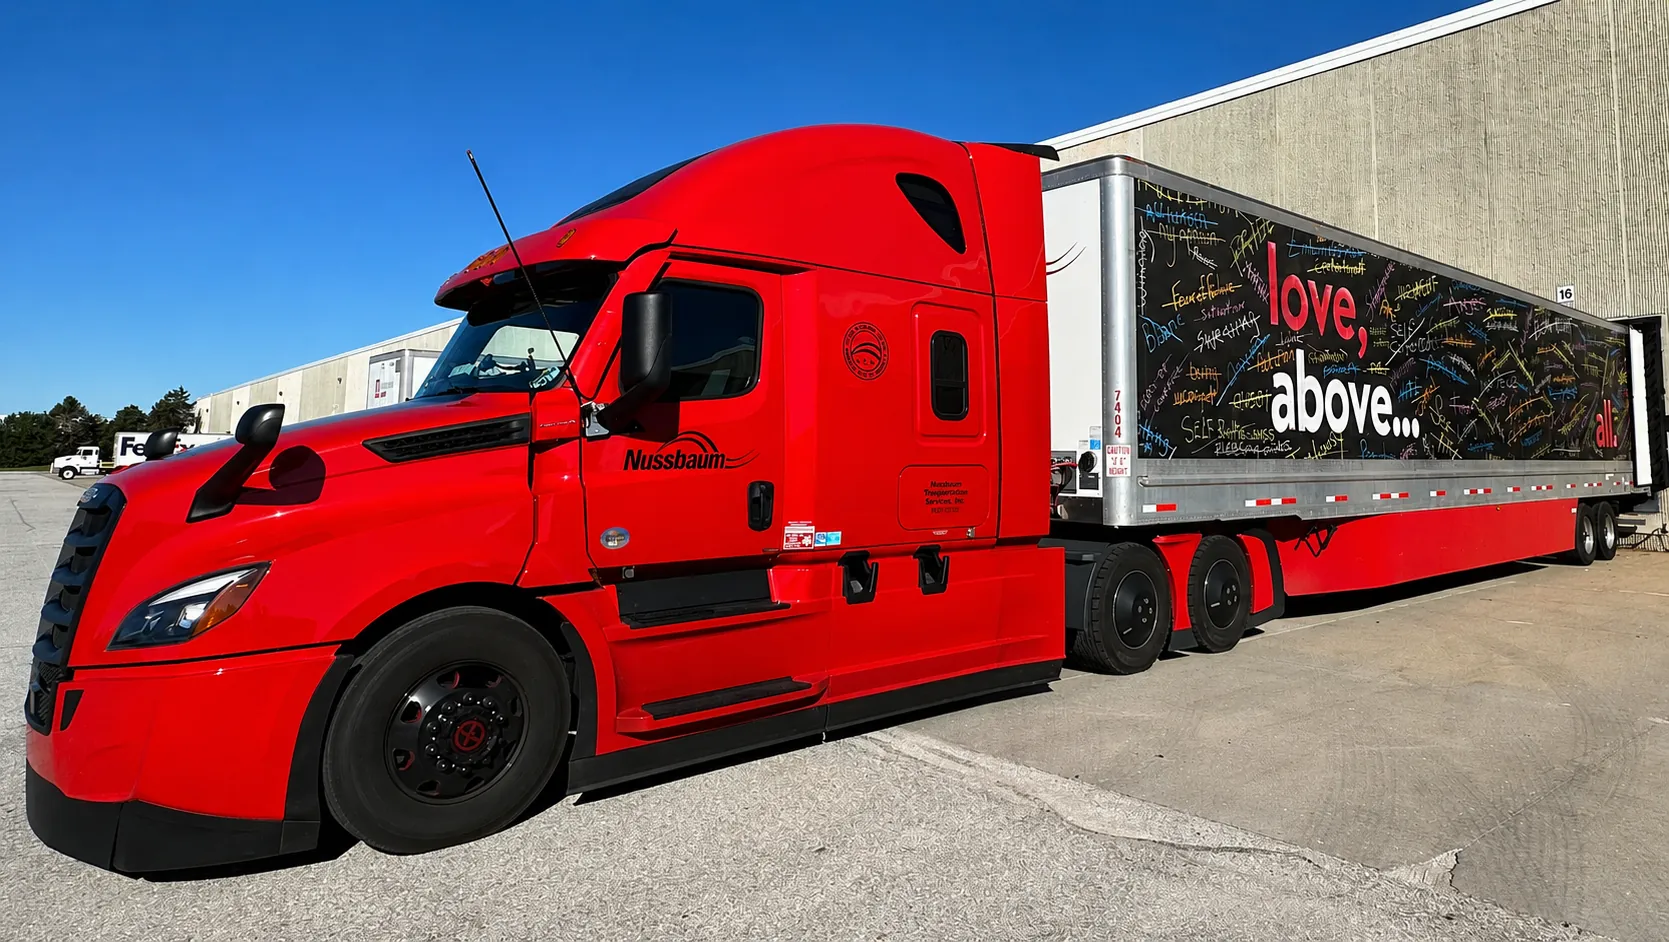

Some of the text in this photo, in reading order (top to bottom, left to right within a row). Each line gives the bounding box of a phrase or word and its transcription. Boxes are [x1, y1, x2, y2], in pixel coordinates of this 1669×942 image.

[1267, 241, 1368, 359] love,
[1559, 288, 1573, 300] 16
[1114, 389, 1122, 438] 7404
[1271, 348, 1421, 439] above...
[1595, 399, 1618, 448] all.
[623, 449, 726, 471] Nussbaum
[1107, 446, 1130, 455] CAUTION
